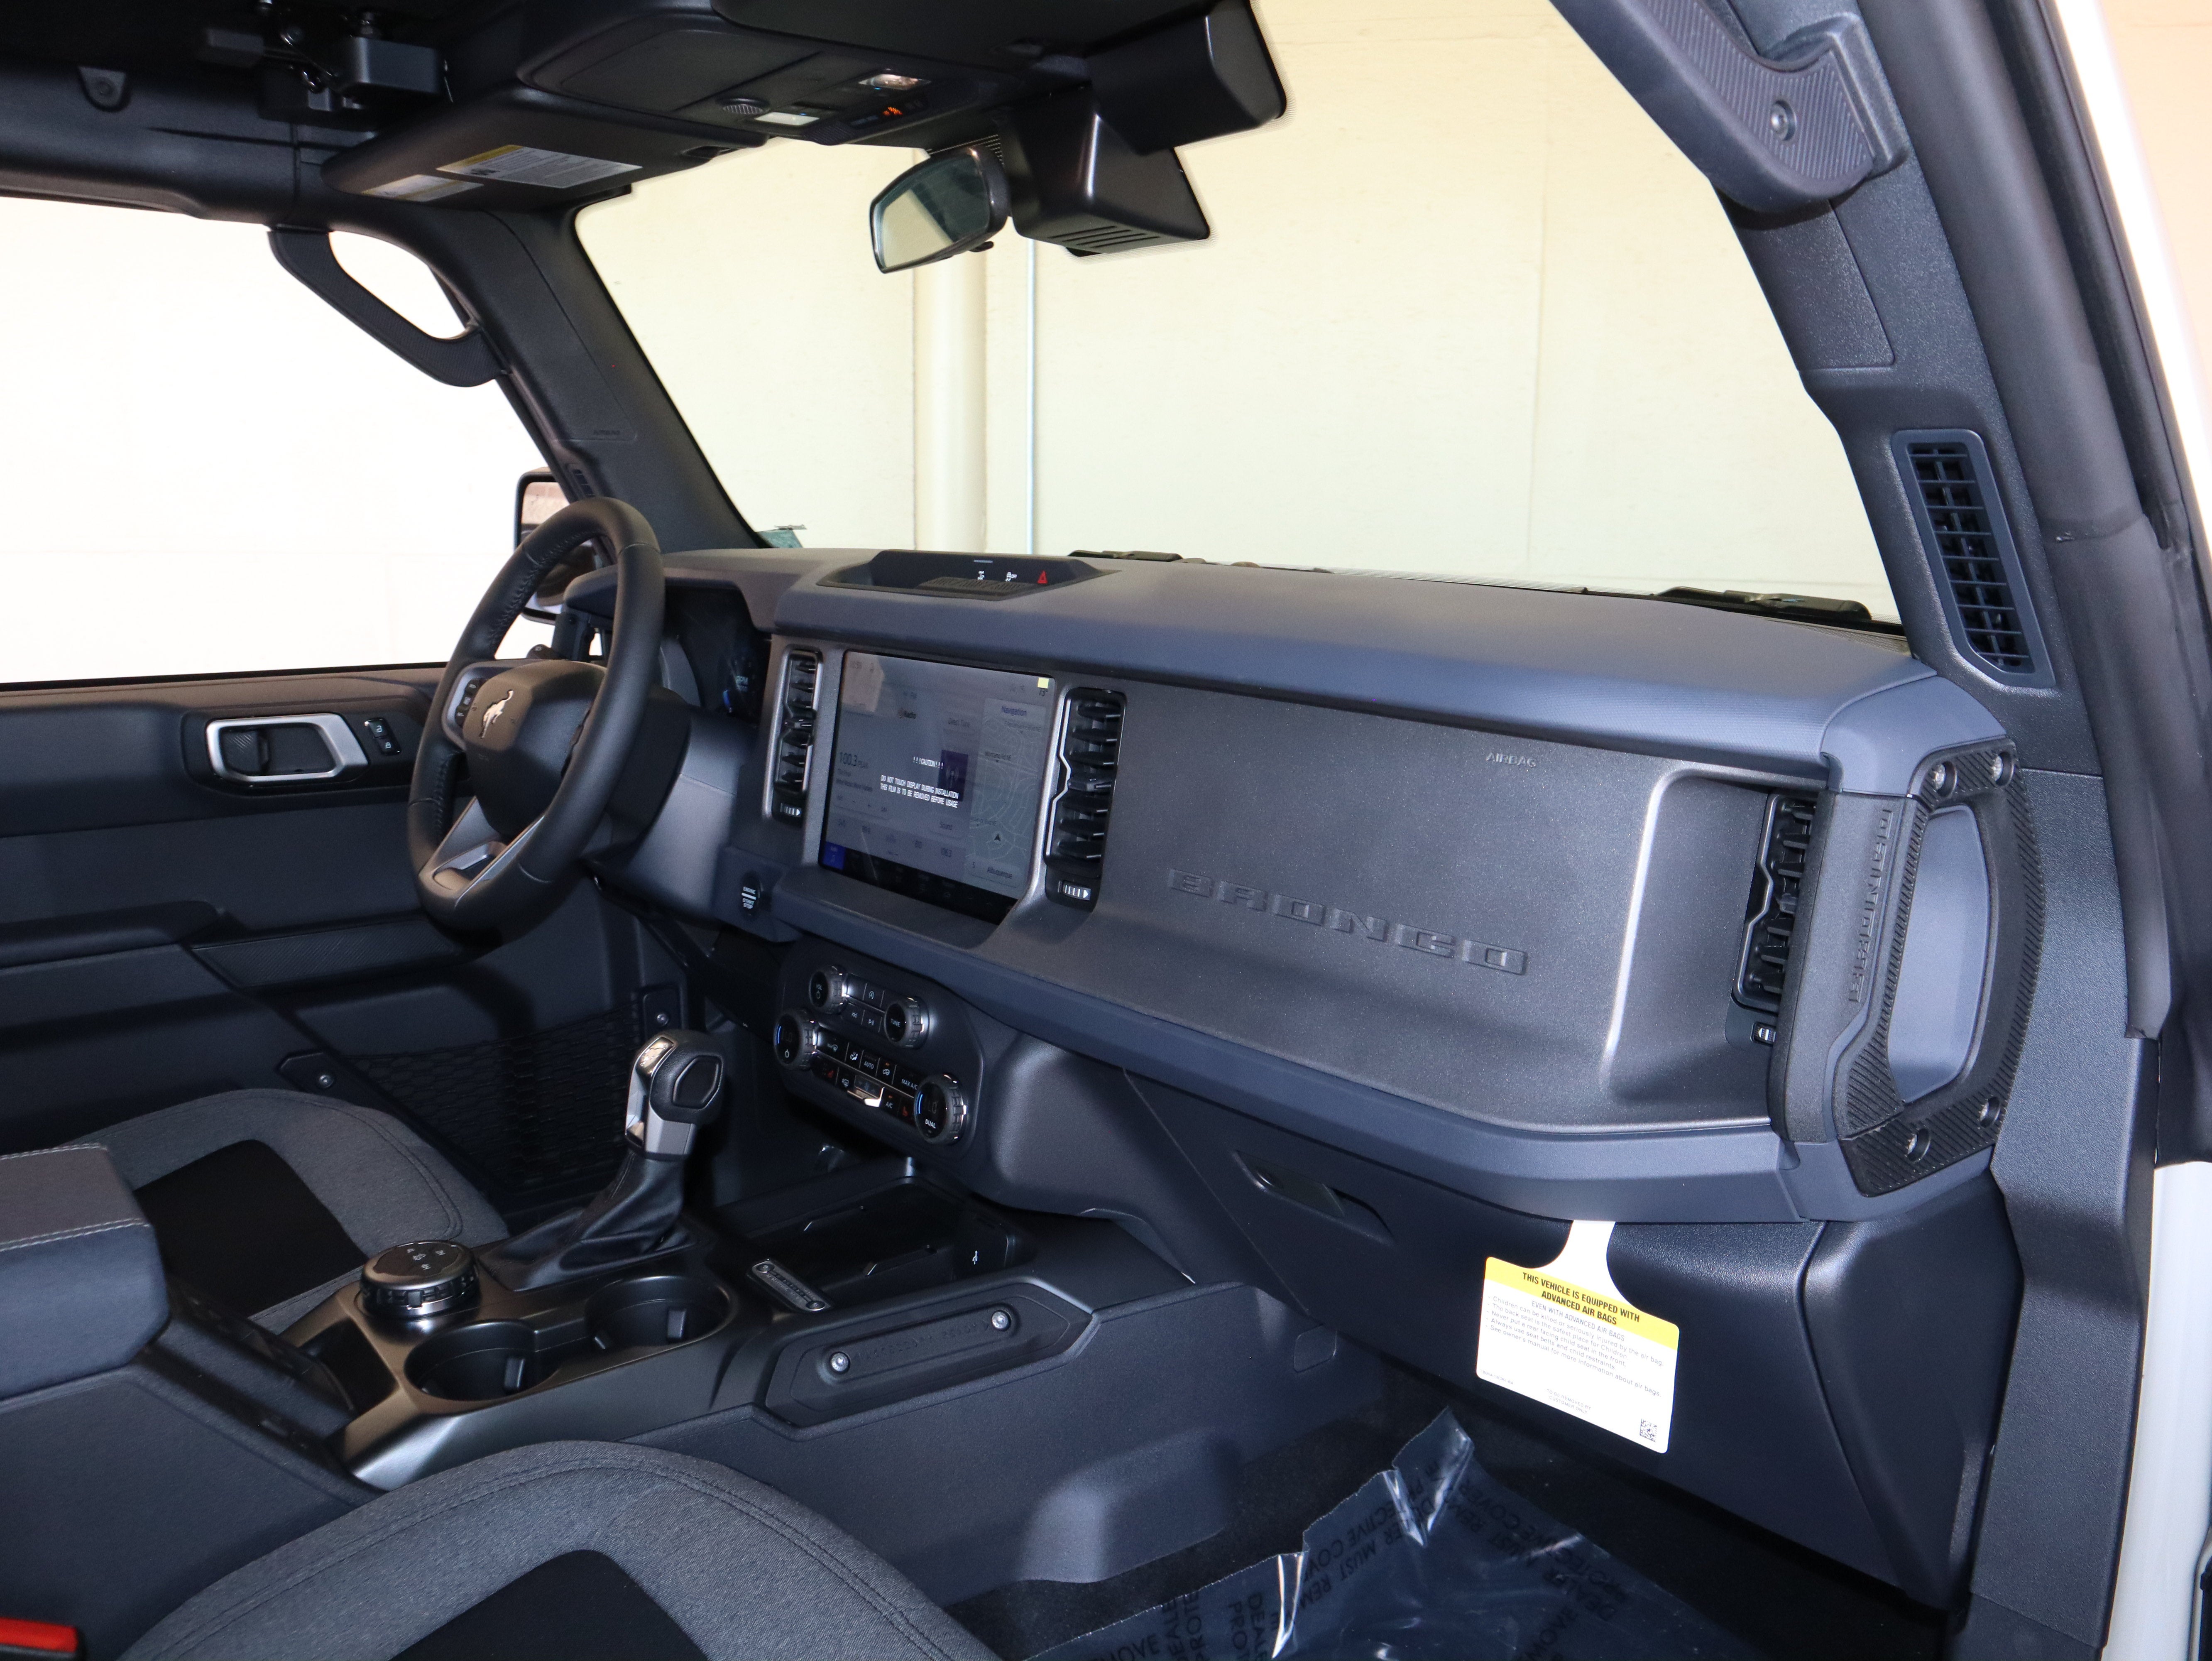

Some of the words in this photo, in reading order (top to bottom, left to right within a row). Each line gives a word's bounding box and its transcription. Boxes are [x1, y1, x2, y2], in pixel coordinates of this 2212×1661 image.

[1485, 752, 1537, 768] AIRBAG
[895, 778, 906, 786] TOUCH
[907, 781, 921, 790] DISPLAY
[921, 784, 934, 793] DURING
[935, 788, 959, 799] INSTALLATION
[913, 791, 930, 801] REMOVED
[930, 795, 945, 805] BEFORE
[946, 799, 958, 808] USAGE
[1167, 868, 1530, 976] BRONCO
[1847, 808, 1896, 1004] BRONCO
[891, 1019, 900, 1027] TUNE
[864, 1061, 874, 1069] AUTO
[902, 1078, 910, 1087] MAX
[925, 1119, 936, 1129] DUAL
[1523, 1272, 1539, 1284] THIS
[1541, 1279, 1570, 1296] VEHICLE
[1572, 1291, 1579, 1299] IS
[1581, 1294, 1618, 1313] EQUIPPED
[1620, 1308, 1639, 1322] WITH
[1541, 1291, 1580, 1311] ADVANCED
[1582, 1306, 1595, 1316] AIR
[1597, 1311, 1617, 1325] BAGS
[1490, 1318, 1512, 1330] Always
[1526, 1331, 1539, 1340] seat
[1540, 1336, 1555, 1346] belts
[1556, 1343, 1568, 1351] and
[1569, 1348, 1585, 1358] child
[1491, 1310, 1509, 1321] Never
[1540, 1328, 1559, 1341] facing
[1560, 1337, 1576, 1346] child
[1576, 1343, 1590, 1352] seat
[1598, 1351, 1608, 1360] the
[1492, 1303, 1503, 1312] The
[1505, 1308, 1519, 1317] back
[1520, 1314, 1533, 1323] seat
[1552, 1326, 1571, 1337] safest
[1572, 1334, 1589, 1344] place
[1493, 1296, 1518, 1309] Children
[1541, 1313, 1557, 1324] killed
[1566, 1324, 1595, 1340] seriously
[1596, 1335, 1618, 1348] injured
[1619, 1344, 1627, 1352] by
[1629, 1347, 1639, 1356] the
[1532, 1301, 1546, 1311] EVEN
[1548, 1307, 1563, 1317] WITH
[1564, 1313, 1595, 1330] ADVANCED
[1597, 1325, 1607, 1334] AIR
[1609, 1330, 1625, 1341] BAGS
[1490, 1324, 1501, 1333] See
[1527, 1340, 1549, 1351] manual
[1561, 1352, 1577, 1362] more
[1578, 1358, 1613, 1377] information
[1615, 1374, 1633, 1385] about
[1549, 1395, 1574, 1409] CUSTOMER
[1575, 1406, 1588, 1414] ONLY
[1561, 1394, 1584, 1407] REMOVED
[1339, 1540, 1377, 1582] MUST
